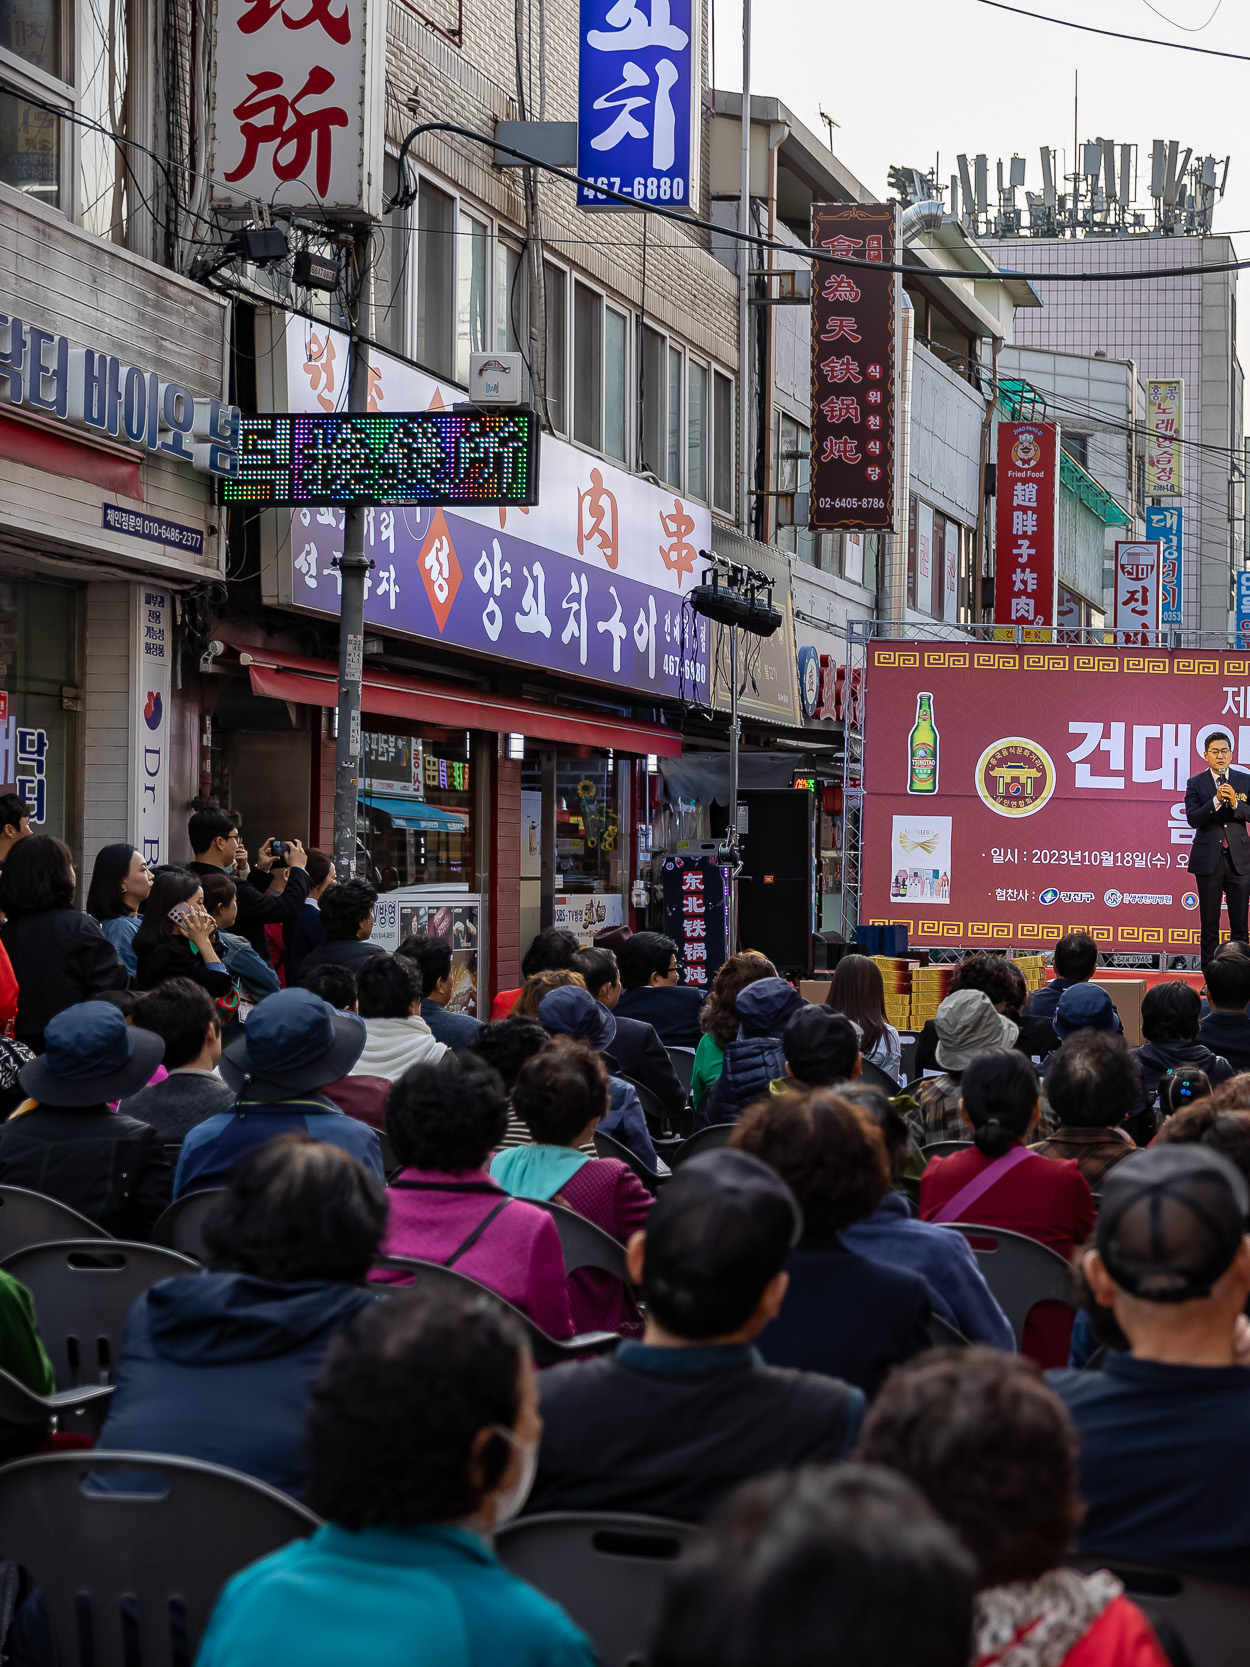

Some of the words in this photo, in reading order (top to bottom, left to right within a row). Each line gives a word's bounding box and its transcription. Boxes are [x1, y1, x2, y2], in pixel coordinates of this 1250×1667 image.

[221, 0, 352, 198] 所
[583, 178, 684, 201] 467-6880
[1155, 402, 1176, 482] 노래연습장
[1008, 470, 1026, 478] Fried
[1027, 470, 1044, 478] Food
[819, 497, 885, 510] 02-6405-8786
[106, 508, 143, 534] 체인점문의
[144, 520, 202, 548] 010-6486-2377
[911, 759, 936, 767] TSINGTAO
[991, 847, 1019, 865] 일시
[1031, 849, 1172, 869] 2023년10월18일(수)
[994, 888, 1030, 903] 협찬사
[1060, 892, 1096, 904] 광진구
[682, 872, 708, 985] 东北铁锅炖
